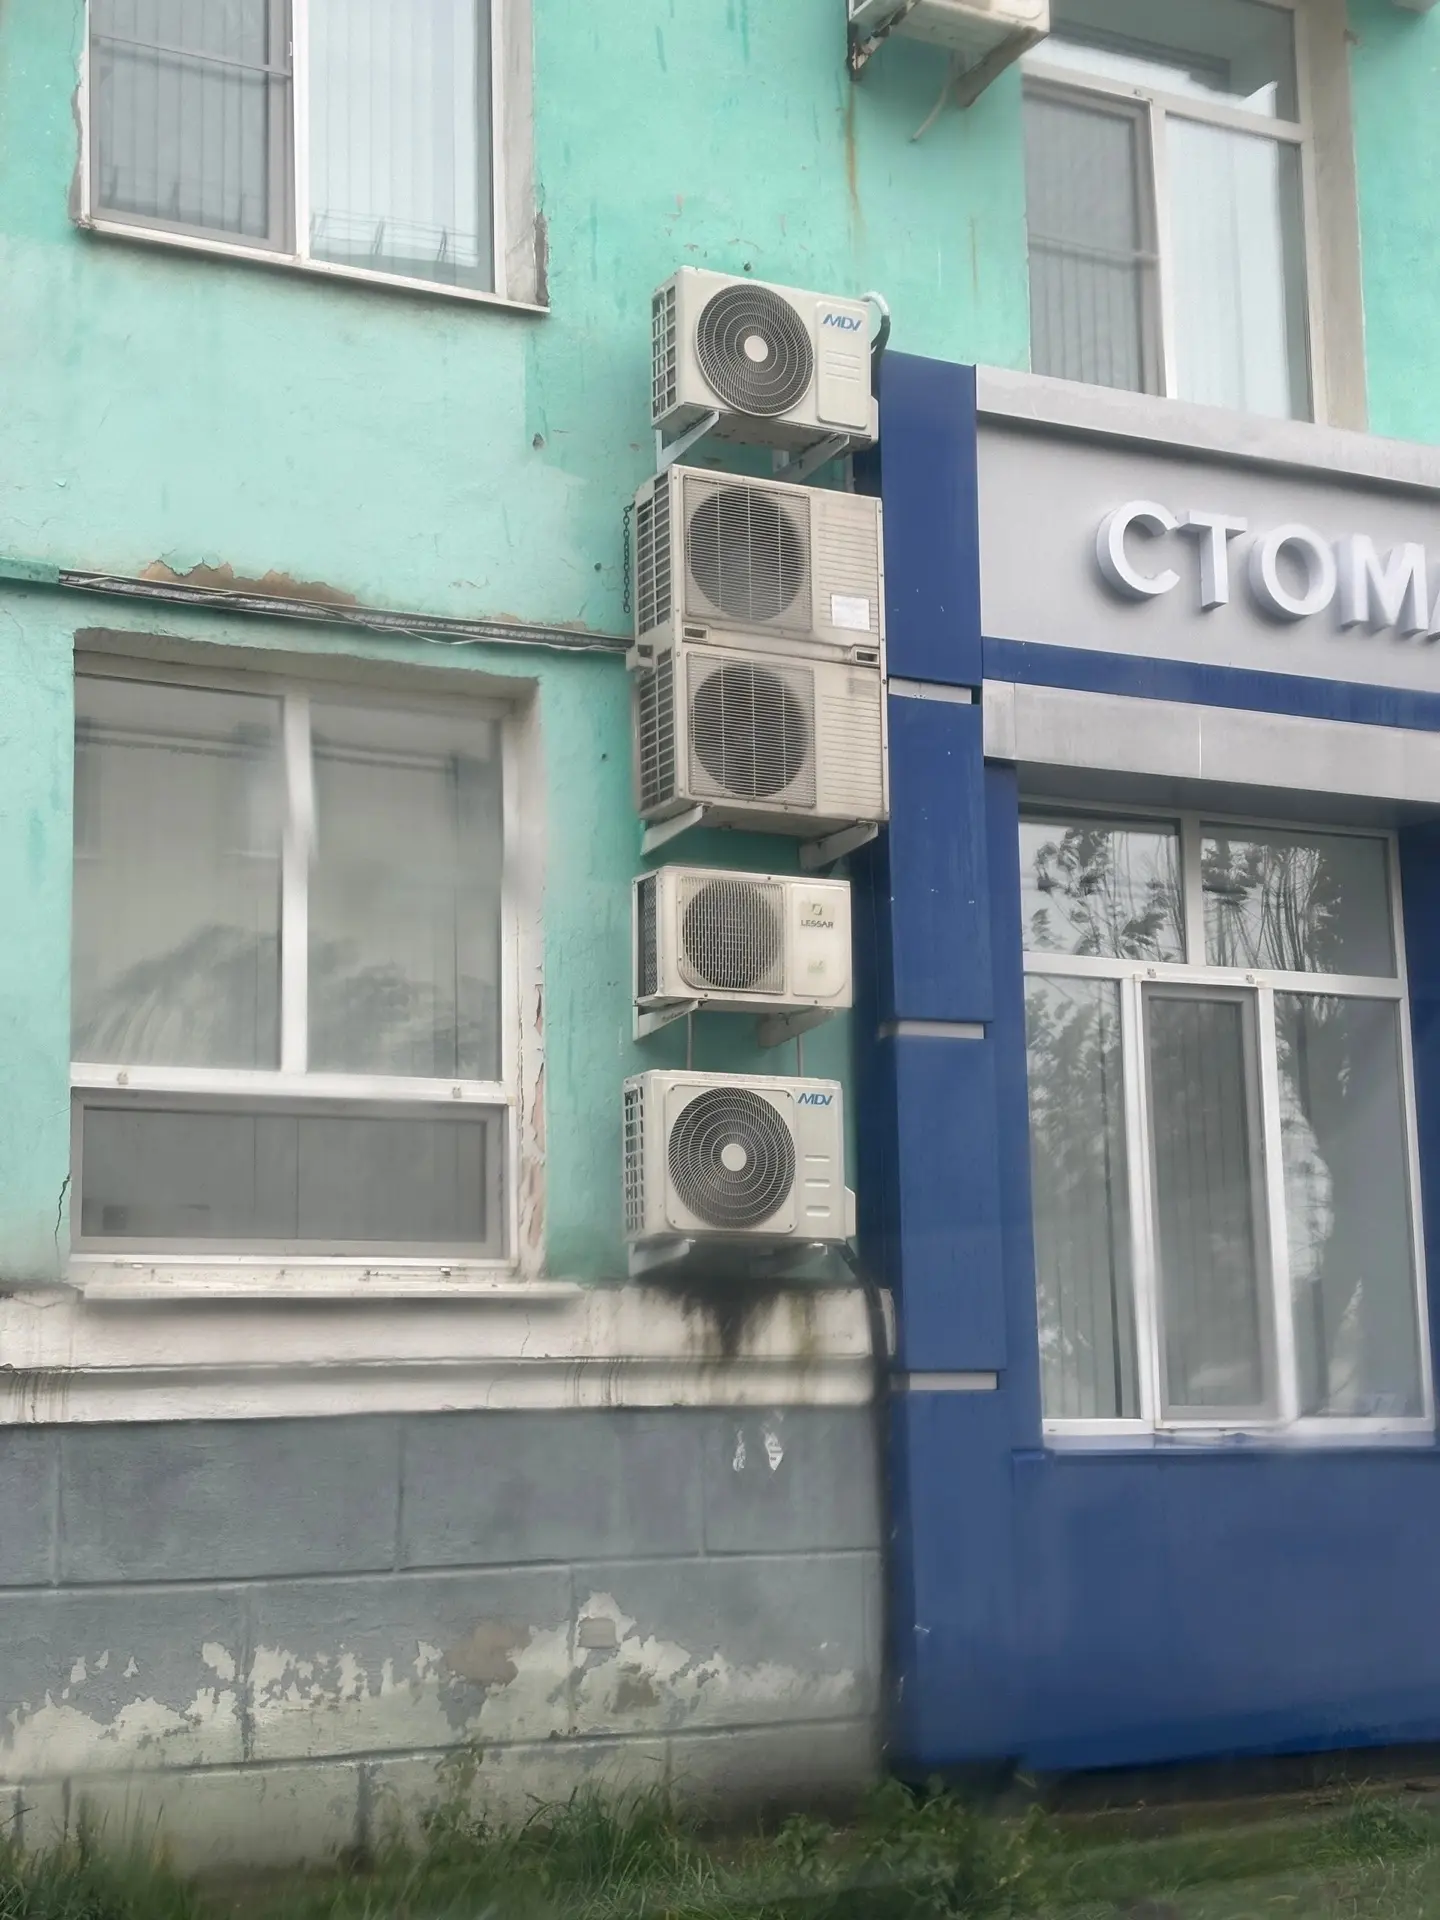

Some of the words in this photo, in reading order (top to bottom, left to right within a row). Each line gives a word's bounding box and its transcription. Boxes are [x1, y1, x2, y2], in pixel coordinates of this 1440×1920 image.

[823, 314, 862, 331] MDV
[1096, 499, 1440, 638] СТОМ
[800, 919, 834, 929] LESSAR
[797, 1092, 834, 1106] MDV
